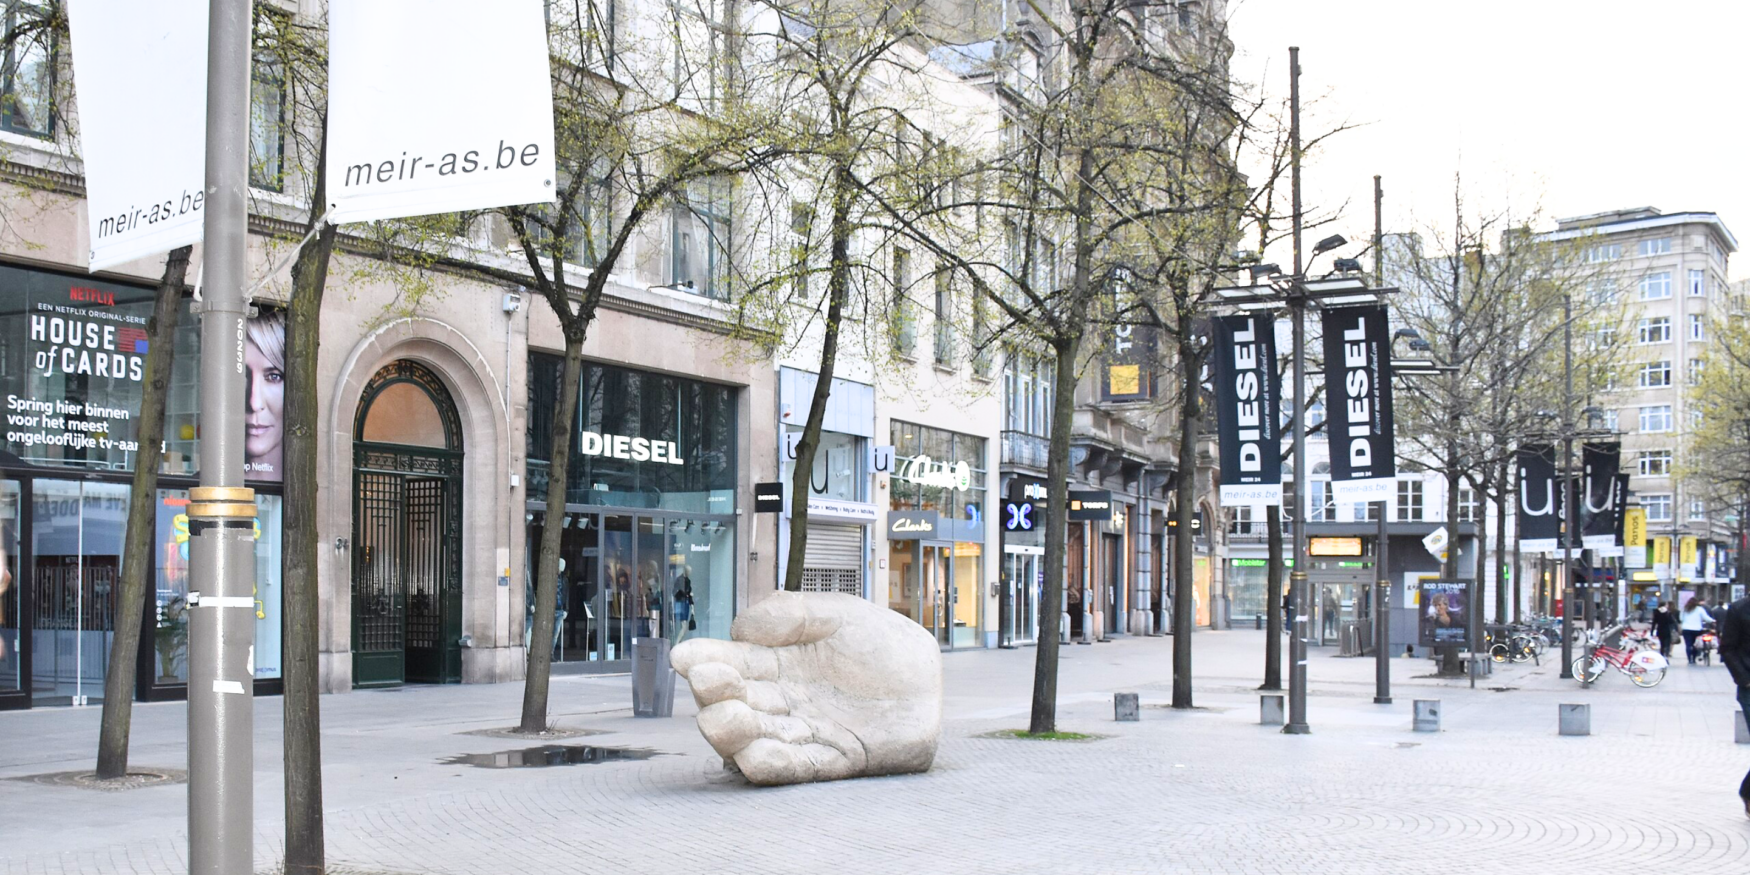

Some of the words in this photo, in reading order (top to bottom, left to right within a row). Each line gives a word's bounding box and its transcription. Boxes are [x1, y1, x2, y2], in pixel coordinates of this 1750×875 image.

[343, 138, 540, 187] meir-as.be
[98, 188, 204, 239] meir-as.be
[69, 286, 116, 307] NETFLIX
[37, 302, 54, 311] EEN
[55, 304, 87, 316] NETFLIX
[88, 310, 147, 325] ORIGINAL-SERIE
[31, 314, 116, 350] HOUSE
[236, 319, 244, 373] 20239
[35, 346, 57, 377] of
[60, 348, 143, 382] CARDS
[1234, 318, 1261, 472] DIESEL
[1344, 317, 1372, 468] DIESEL
[7, 394, 53, 415] Spring
[55, 400, 83, 416] hier
[84, 402, 130, 420] binnen
[7, 413, 40, 425] voor
[41, 414, 65, 429] het
[67, 418, 109, 433] meest
[6, 431, 97, 450] ongelooflijke
[581, 431, 684, 465] DIESEL
[251, 462, 274, 473] Netflix
[1224, 489, 1278, 499] meir-as.be
[1340, 482, 1388, 494] meir-as.be
[892, 518, 932, 532] Clarks
[1631, 516, 1639, 545] Panos
